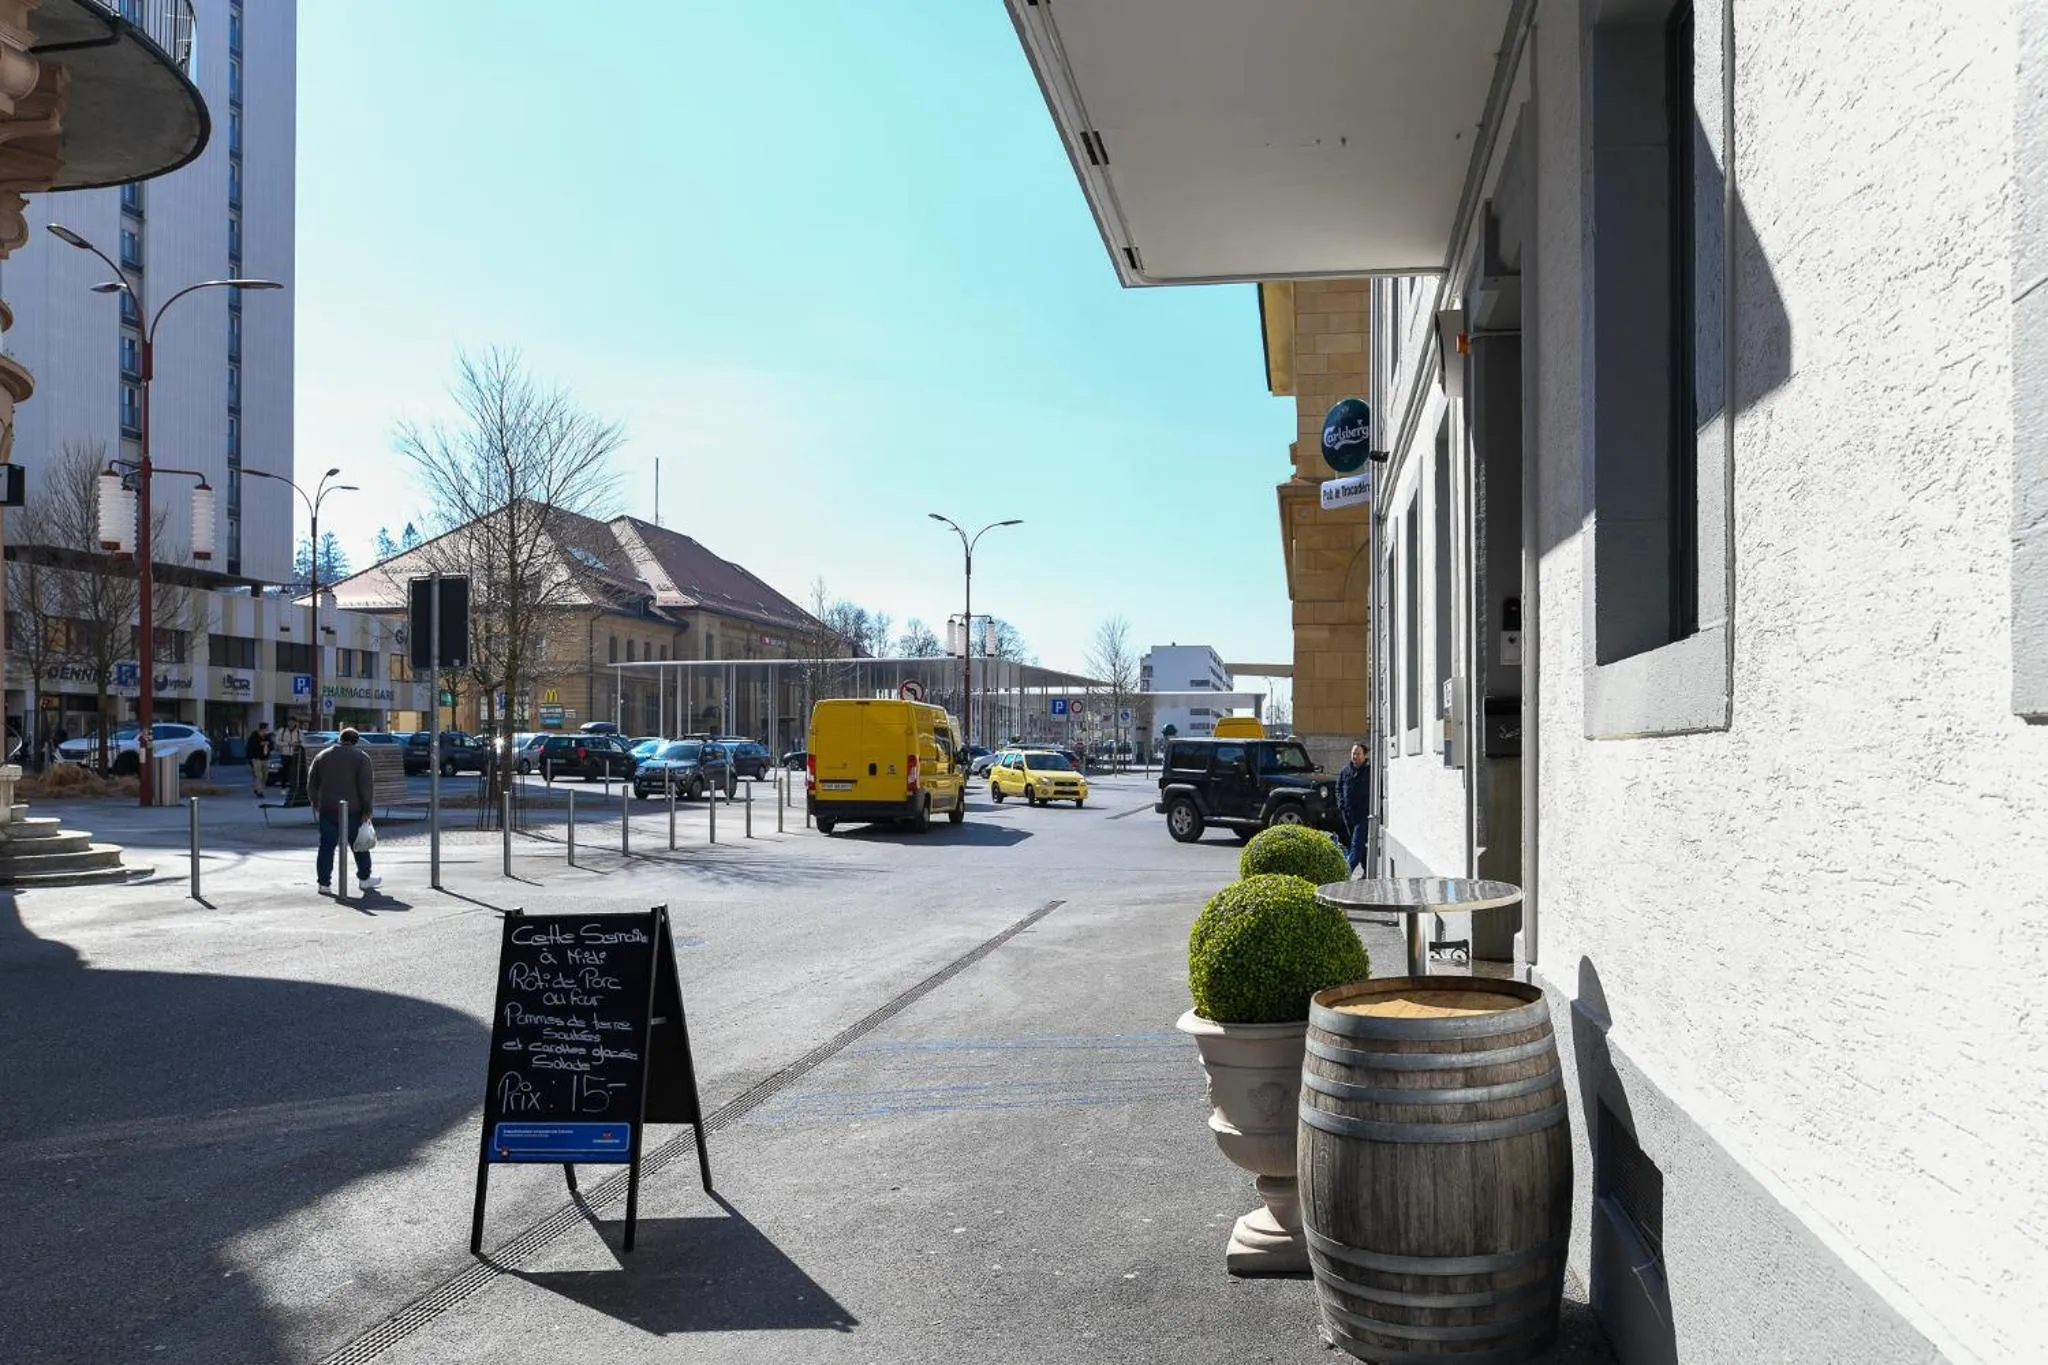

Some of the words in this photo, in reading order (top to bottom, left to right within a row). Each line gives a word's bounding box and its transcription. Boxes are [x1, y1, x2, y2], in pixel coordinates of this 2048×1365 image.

[1323, 420, 1369, 449] Carlsberg
[1323, 487, 1334, 500] Pub
[511, 923, 576, 945] Cette
[567, 947, 607, 965] Midi
[578, 966, 622, 989] Porc
[504, 1001, 565, 1027] Pommes
[567, 1013, 587, 1027] de
[591, 1011, 633, 1031] terre
[502, 1037, 523, 1050] et
[532, 1054, 591, 1071] Salade
[497, 1070, 541, 1114] Prix
